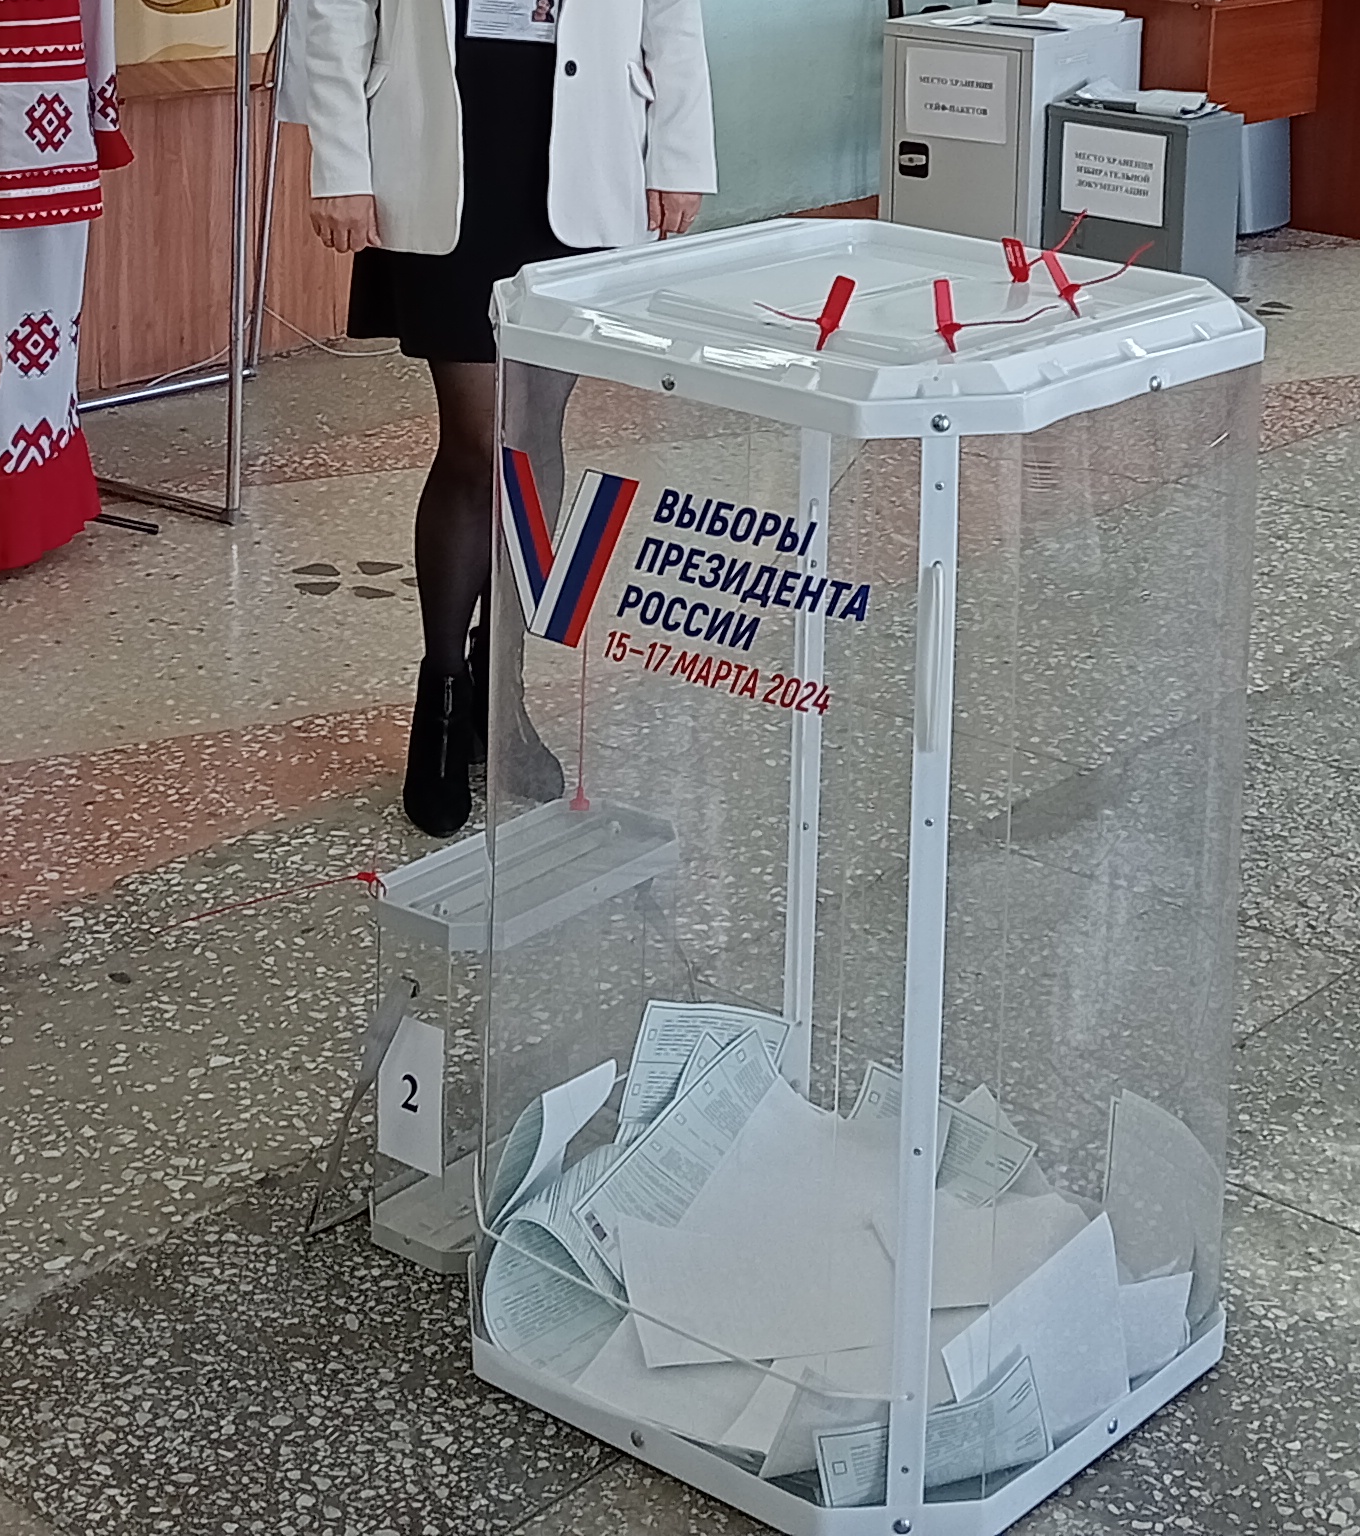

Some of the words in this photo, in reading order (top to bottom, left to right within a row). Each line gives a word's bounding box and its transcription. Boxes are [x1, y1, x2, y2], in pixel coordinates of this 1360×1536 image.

[1075, 150, 1105, 164] МЕСТО
[653, 487, 818, 557] ВЫБОРЫ
[634, 537, 871, 622] ПРЕЗИДЕНТА
[617, 584, 761, 652] РОССИИ
[669, 650, 761, 700] МАРТА
[761, 672, 831, 716] 2024
[400, 1074, 420, 1114] 2
